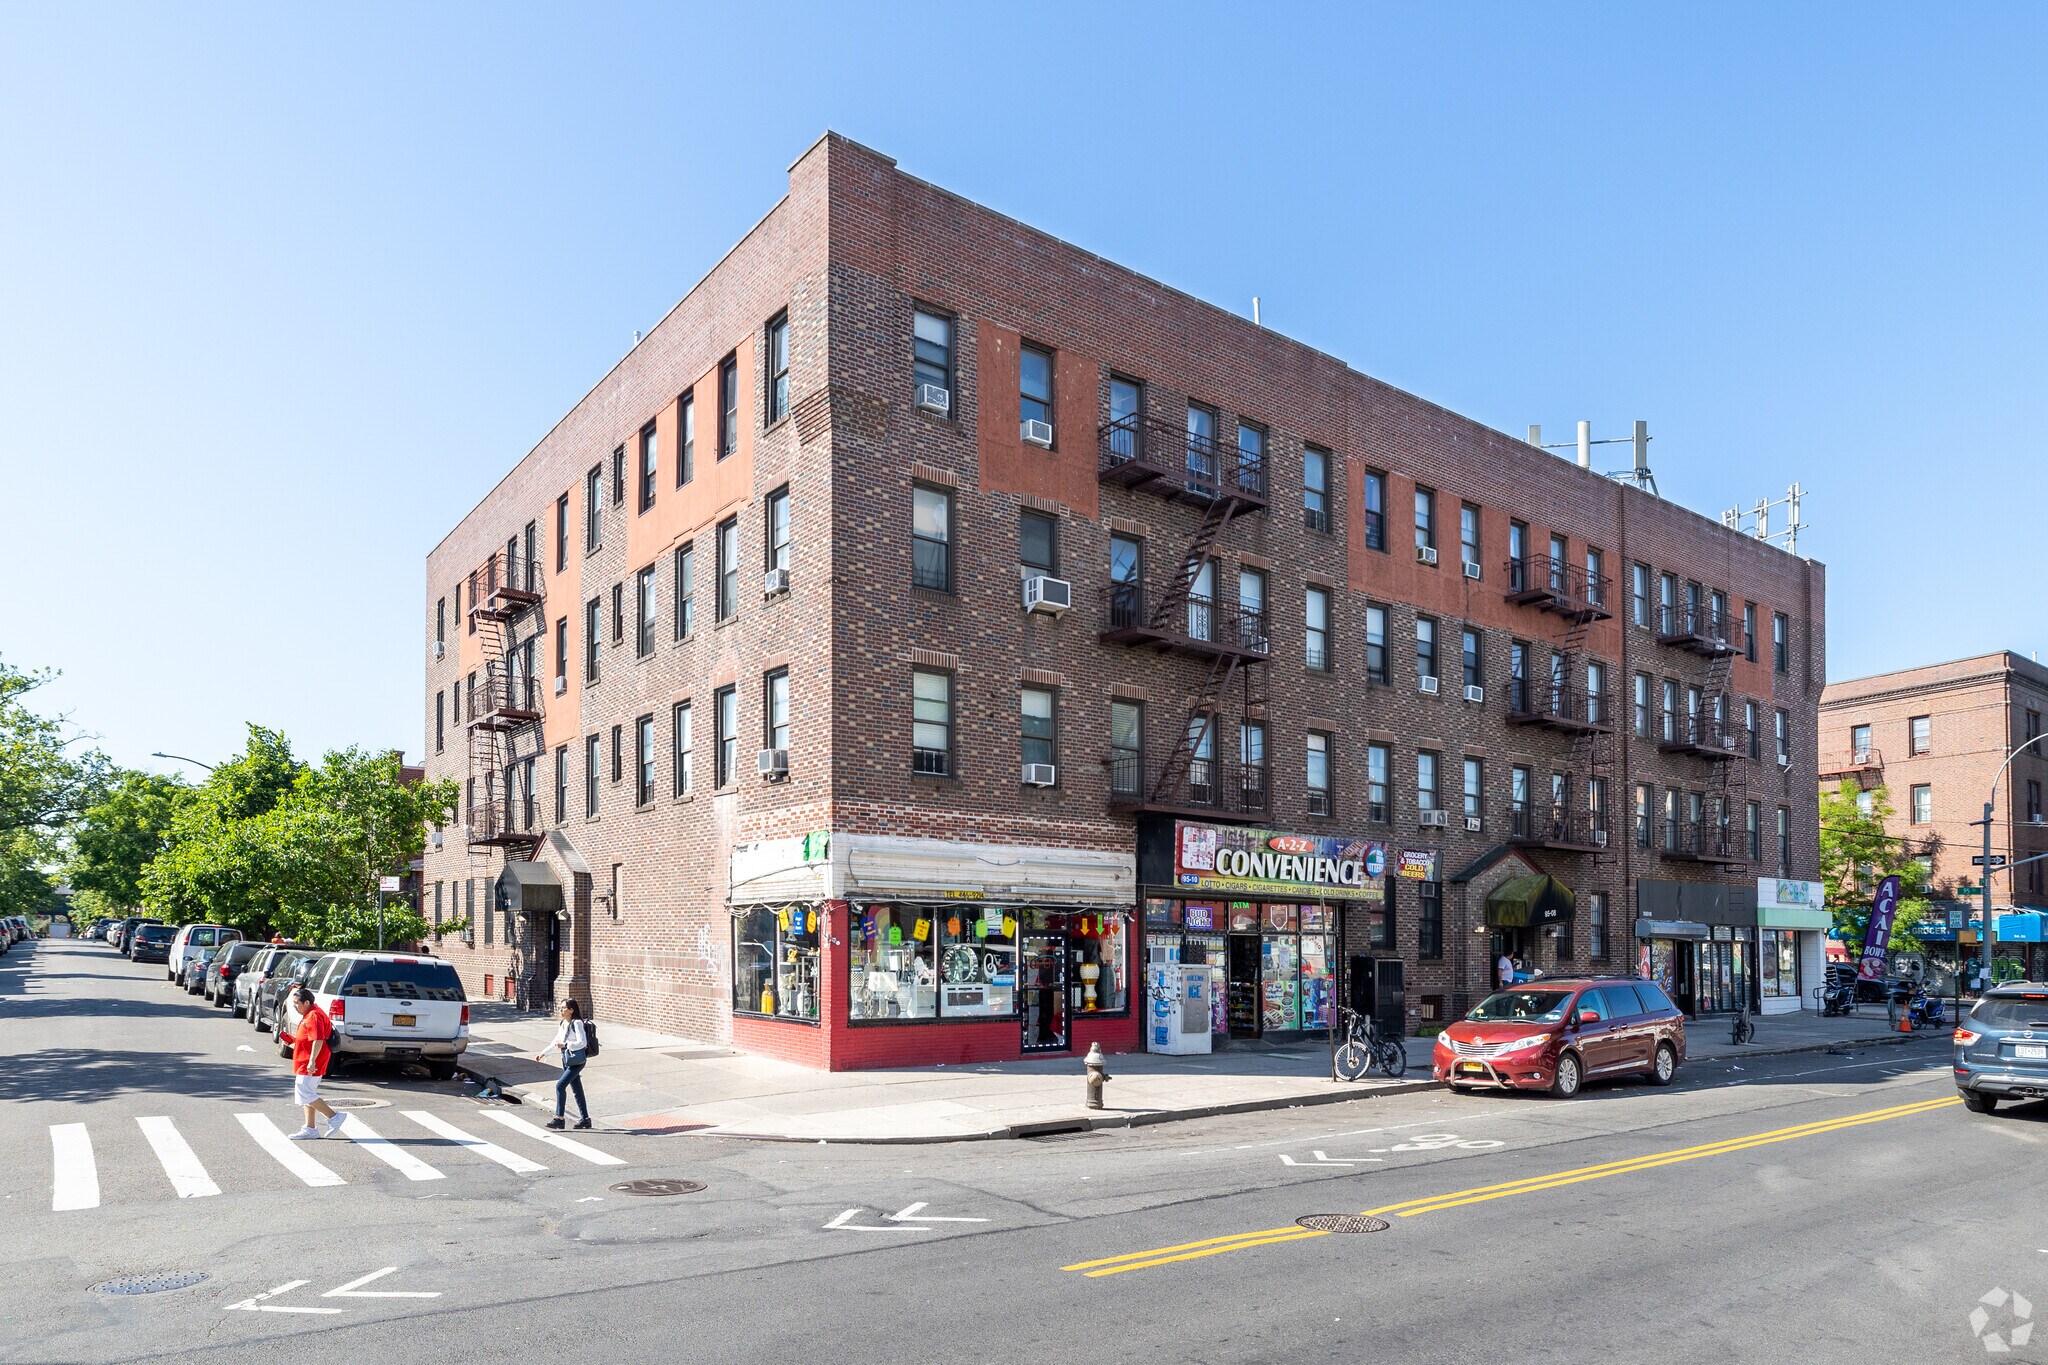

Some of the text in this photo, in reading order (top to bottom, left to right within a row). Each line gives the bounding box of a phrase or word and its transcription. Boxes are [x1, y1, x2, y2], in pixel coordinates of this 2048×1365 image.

[1277, 838, 1307, 851] A-2-Z
[1403, 851, 1428, 860] GROCERY
[1216, 848, 1364, 885] CONVENIENCE
[1406, 858, 1430, 866] TOBACCO
[1401, 870, 1426, 879] BEERS
[1201, 880, 1379, 899] LOTTO CIGARS CIGARETTES CANDIES COLD DRINKS COFFEE
[1233, 901, 1250, 909] ATM
[1189, 908, 1208, 918] BUD
[1187, 917, 1212, 927] LIGHT
[1864, 945, 1885, 958] BOWL
[1188, 984, 1202, 999] ICE
